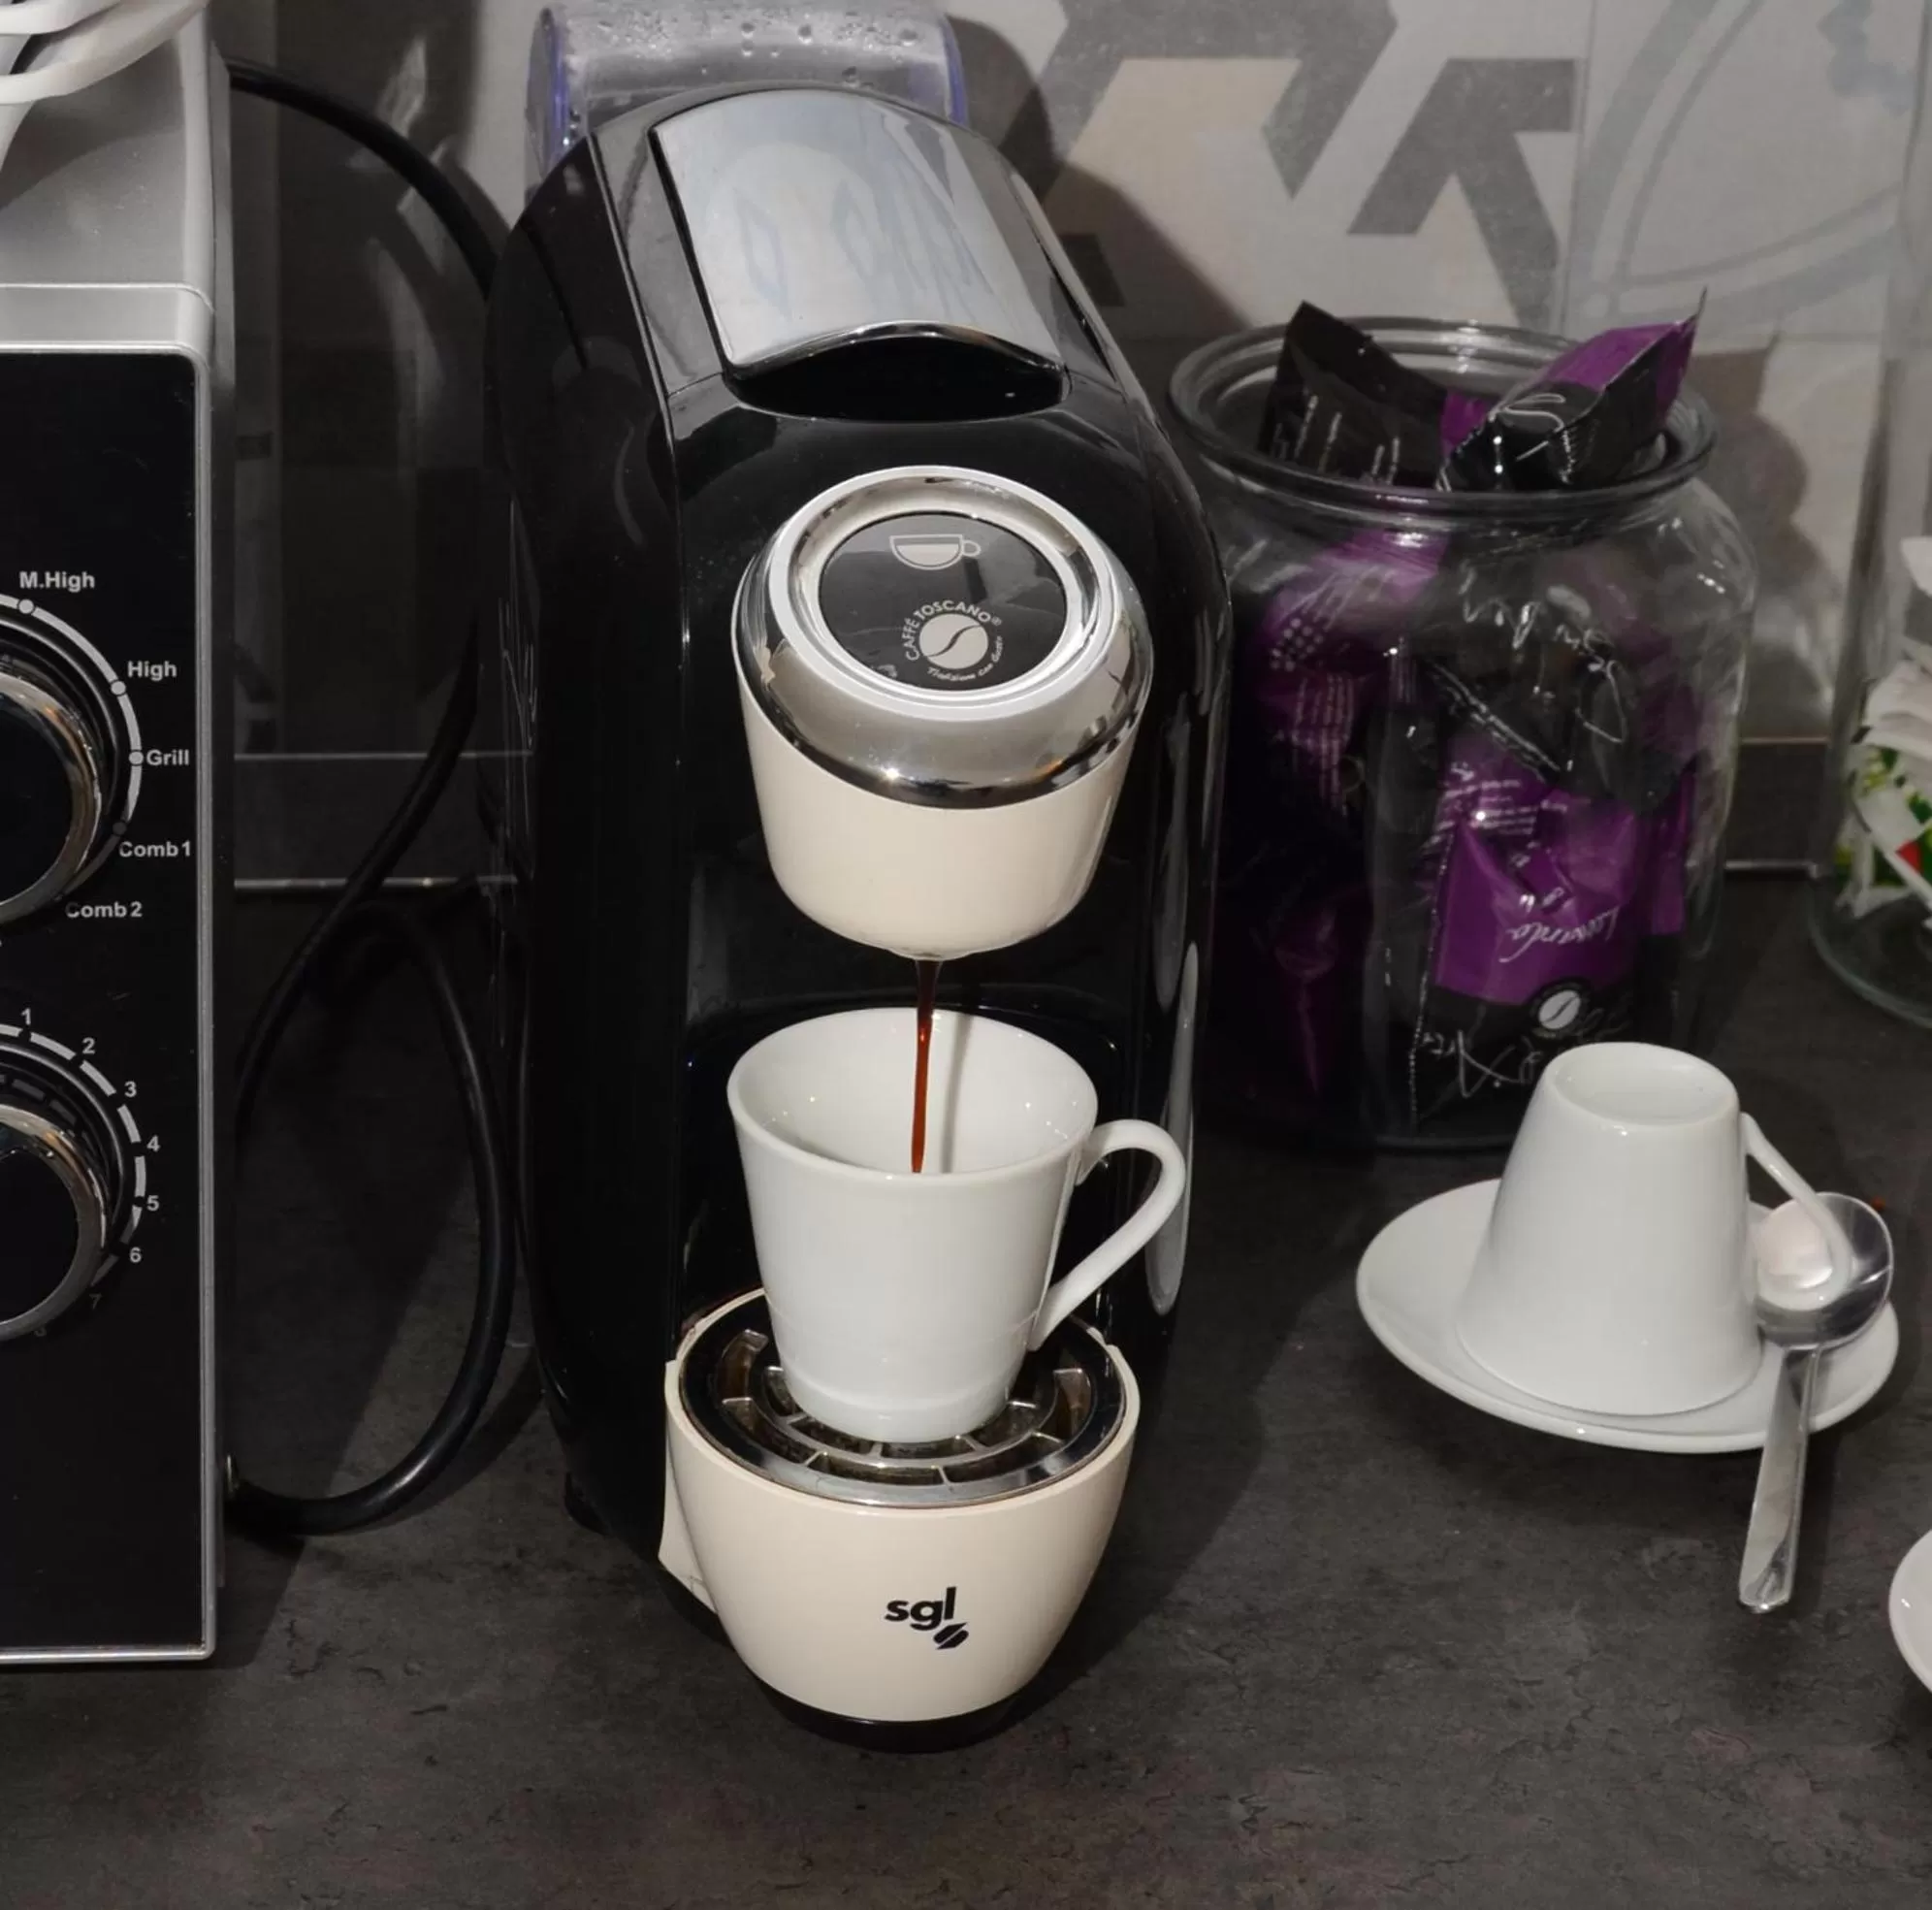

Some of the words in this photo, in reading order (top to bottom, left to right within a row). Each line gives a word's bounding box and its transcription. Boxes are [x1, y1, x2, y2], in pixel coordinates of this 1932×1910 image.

[18, 570, 96, 593] M.High
[127, 660, 178, 682] High
[145, 749, 190, 766] Grill
[20, 1008, 32, 1025] 1
[81, 1038, 96, 1054] 2
[124, 1082, 138, 1098] 3
[146, 1136, 161, 1152] 4
[146, 1195, 160, 1212] 5
[129, 1246, 143, 1263] 6
[884, 1586, 957, 1632] sgl
